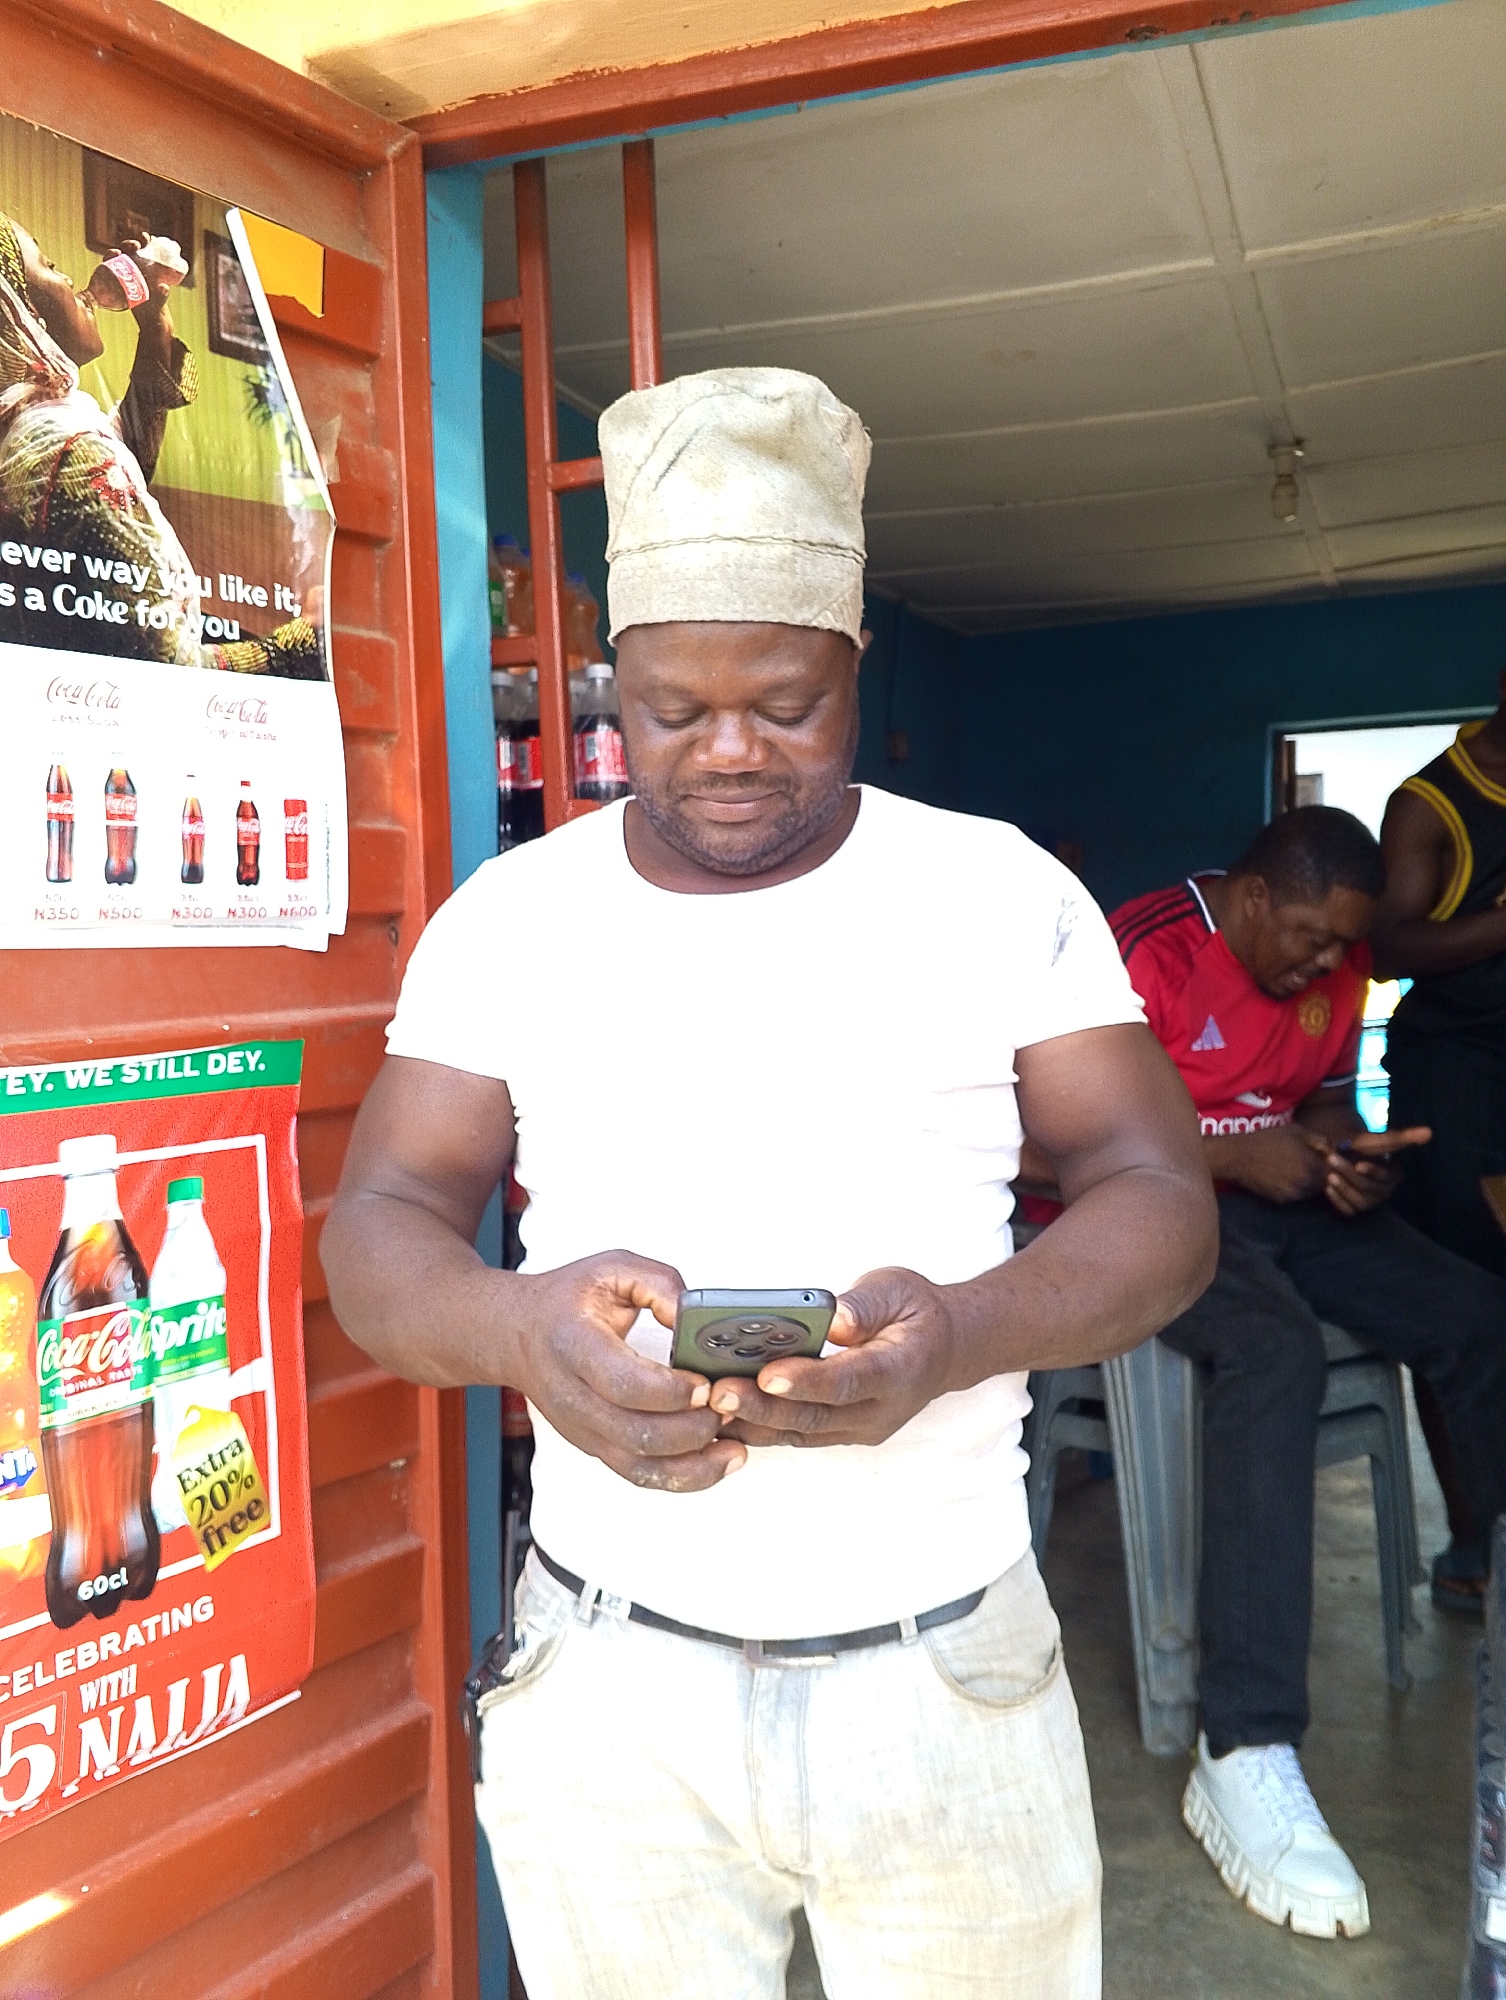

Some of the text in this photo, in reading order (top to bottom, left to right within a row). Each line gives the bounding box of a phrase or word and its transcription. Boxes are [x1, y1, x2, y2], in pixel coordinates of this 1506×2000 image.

[0, 540, 302, 617] ever way you like it,
[24, 586, 47, 612] a
[52, 583, 129, 625] Coke
[135, 604, 187, 631] for
[187, 611, 240, 642] you
[0, 1049, 267, 1096] EY. WE STILL DEY.
[151, 1301, 227, 1361] Sprite
[176, 1438, 246, 1496] Extra
[190, 1456, 256, 1530] 20%
[201, 1497, 266, 1557] free
[77, 1567, 129, 1601] 60cl
[78, 1663, 138, 1714] WITH
[61, 1653, 251, 1799] NAIJA
